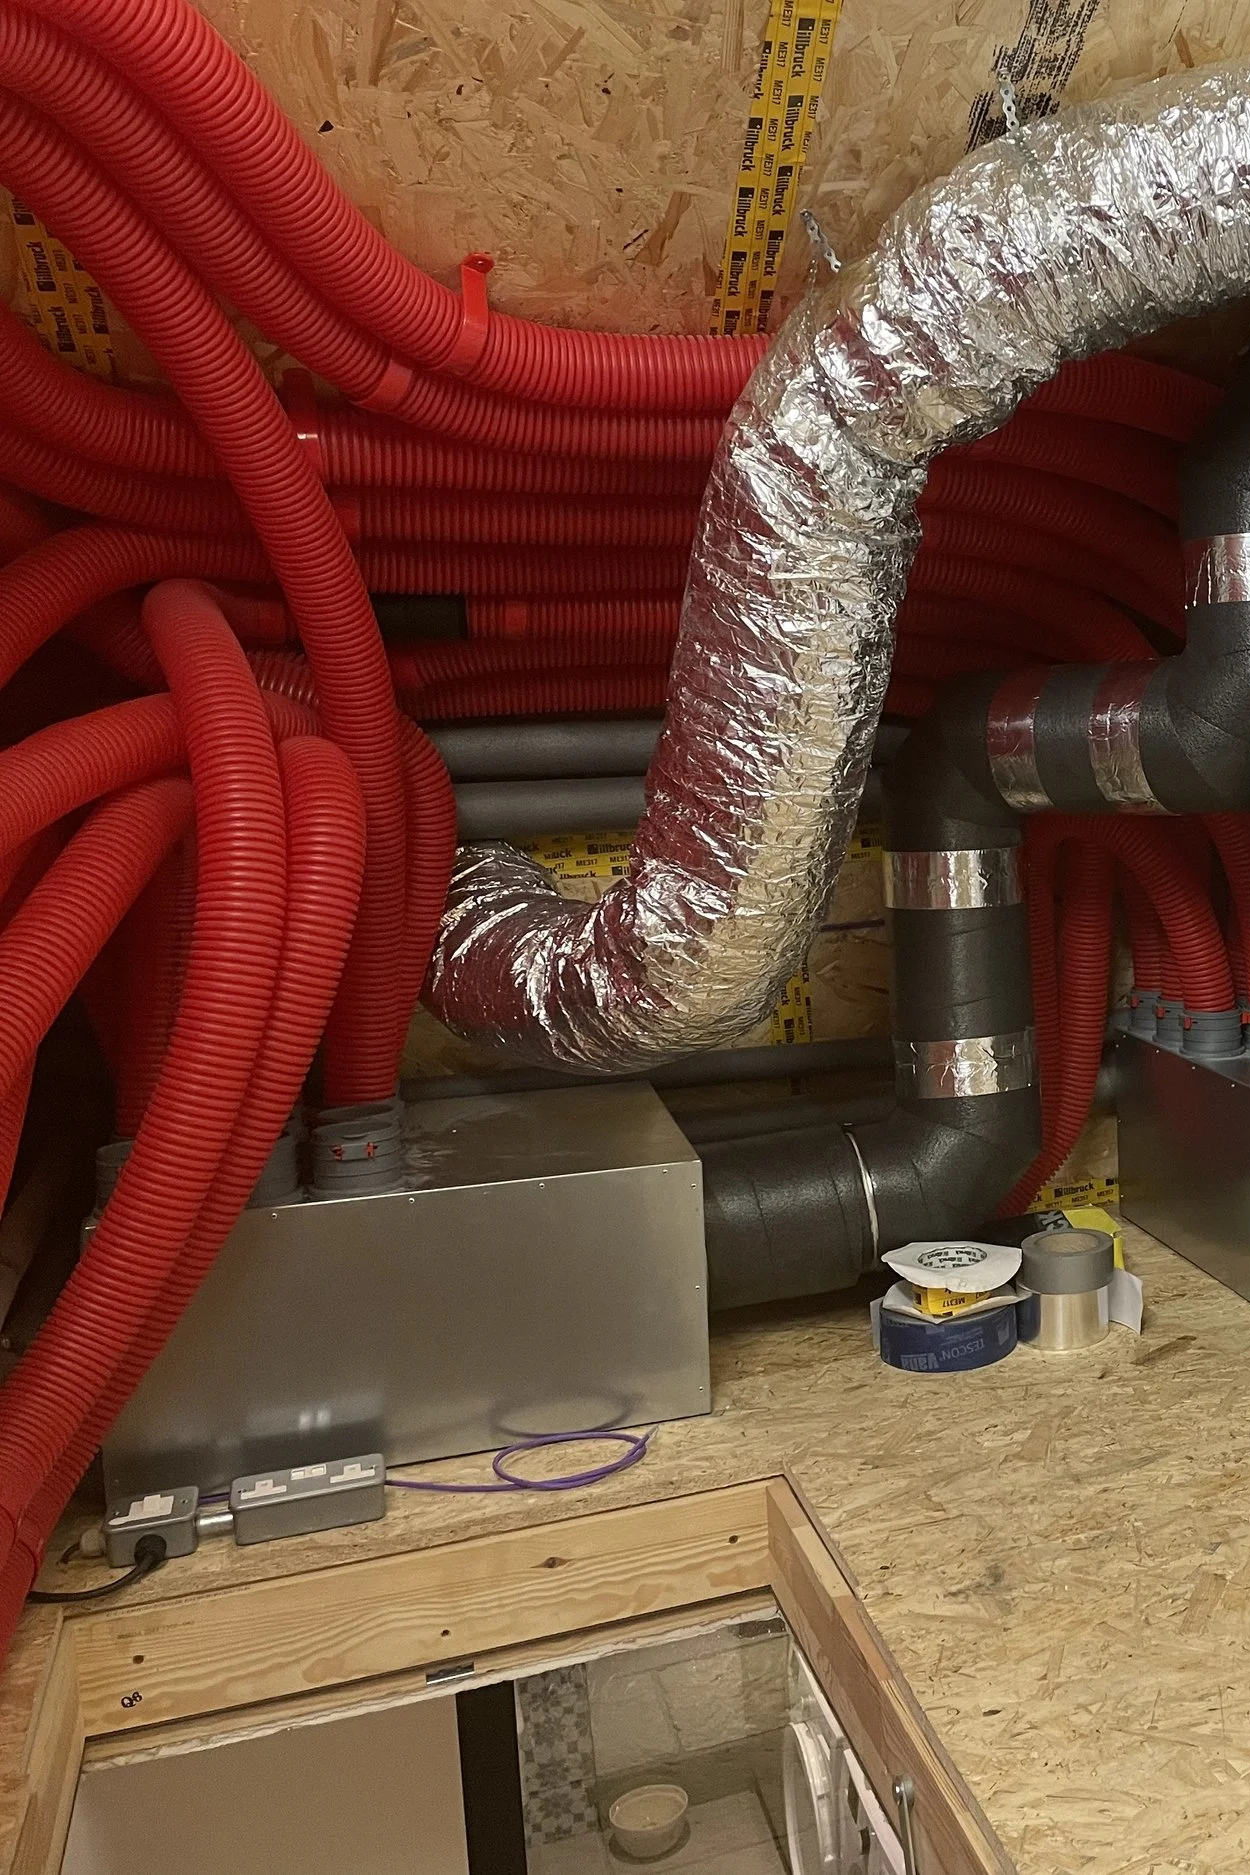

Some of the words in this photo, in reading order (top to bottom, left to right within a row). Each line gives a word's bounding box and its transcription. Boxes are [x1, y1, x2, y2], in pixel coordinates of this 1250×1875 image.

[781, 0, 793, 27] ME317
[819, 19, 832, 45] ME317
[776, 41, 788, 68] ME317
[791, 30, 811, 78] illbruck
[813, 57, 826, 83] ME317
[771, 80, 783, 105] ME317
[807, 95, 819, 120] ME317
[767, 118, 778, 142] ME317
[781, 107, 800, 152] illbruck
[741, 129, 760, 172] illbruck
[763, 153, 774, 177] ME317
[758, 187, 770, 210] ME317
[772, 176, 790, 216] illbruck
[734, 198, 752, 237] illbruck
[763, 240, 781, 277] illbruck
[727, 260, 744, 297] illbruck
[942, 1296, 966, 1308] ME317
[943, 1338, 985, 1361] TESCON
